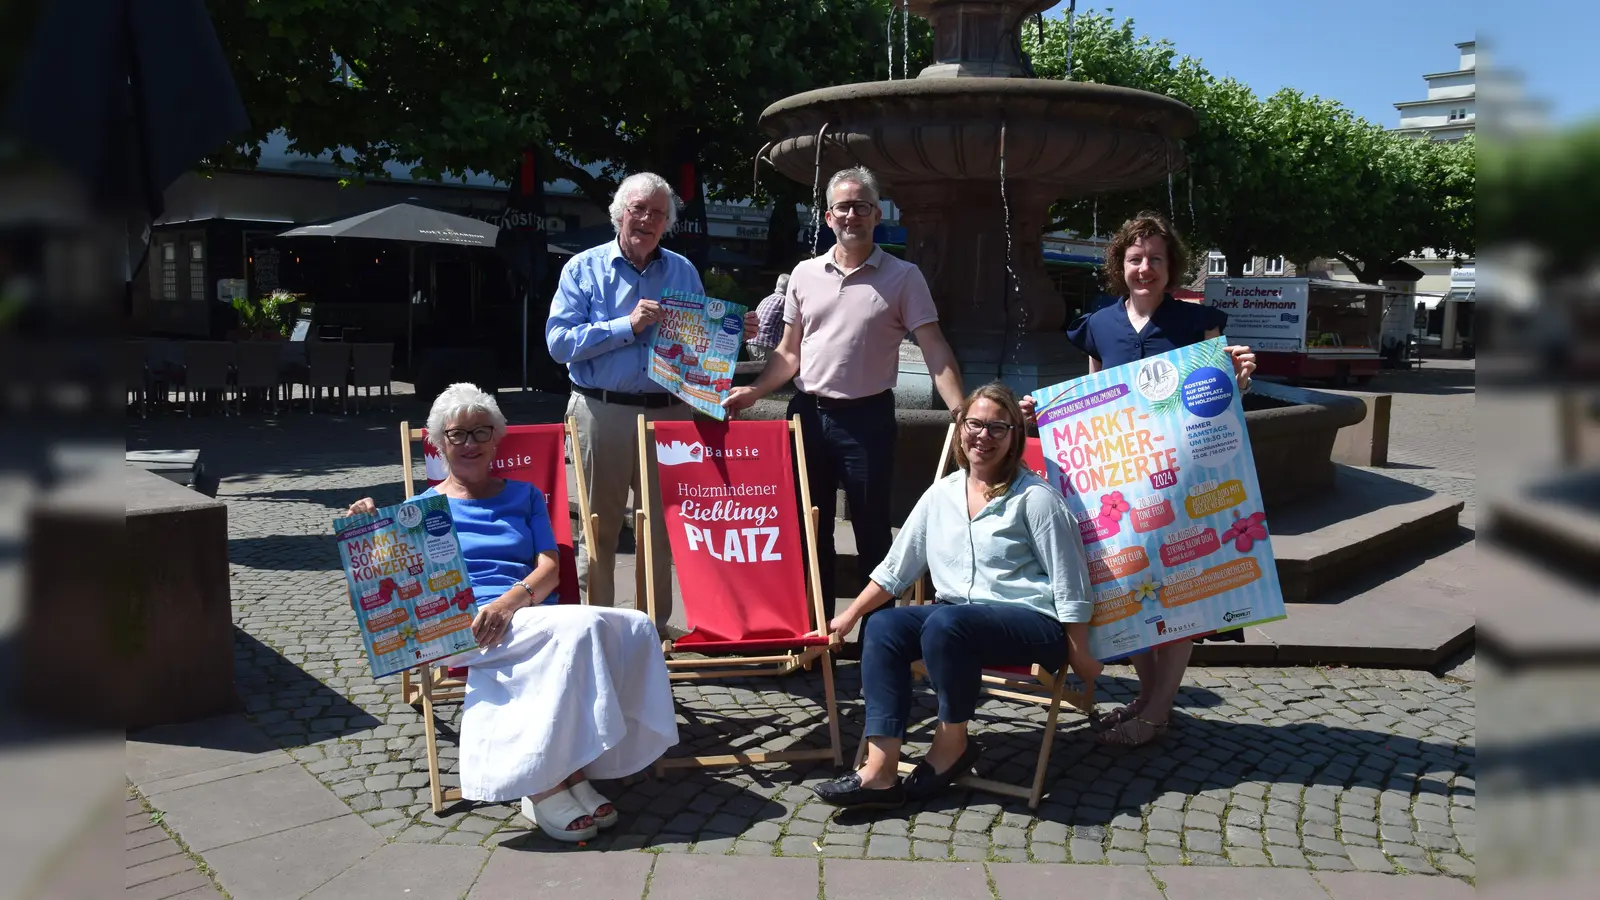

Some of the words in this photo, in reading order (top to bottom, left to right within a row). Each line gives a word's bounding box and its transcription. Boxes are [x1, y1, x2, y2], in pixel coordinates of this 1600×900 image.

[1226, 286, 1282, 297] Fleischerei
[1212, 299, 1239, 309] Dierk
[1243, 299, 1296, 309] Brinkmann
[662, 318, 711, 336] SOMMER-
[658, 328, 711, 348] KONZERTE
[1184, 378, 1216, 390] KOSTENLOS
[1186, 388, 1196, 396] AUF
[1197, 385, 1210, 393] DEM
[1187, 388, 1223, 401] MARKTPLATZ
[1196, 392, 1231, 406] HOLZMINDEN
[1047, 398, 1084, 420] SOMMERABENDE
[1085, 398, 1090, 407] IN
[1090, 387, 1122, 405] HOLZMINDEN
[1052, 406, 1149, 450] MARKT-
[1186, 421, 1212, 432] IMMER
[1188, 425, 1228, 439] SAMSTAGS
[1189, 438, 1202, 447] UM
[1223, 431, 1235, 439] Uhr
[705, 446, 759, 457] Bausie
[1057, 429, 1165, 473] SOMMER-
[1059, 448, 1180, 498] KONZERTE
[1154, 472, 1174, 488] 2024
[678, 483, 777, 498] Holzmindener
[678, 500, 778, 526] Lieblings
[1136, 508, 1152, 521] TONE
[1152, 505, 1165, 516] FISH
[347, 530, 407, 556] MARKT-
[684, 522, 782, 562] PLATZ
[351, 542, 415, 569] SOMMER-
[1092, 554, 1129, 572] COMPLEMENT
[1128, 550, 1143, 561] CLUB
[353, 553, 424, 583] KONZERTE
[1168, 622, 1196, 633] Bausie
